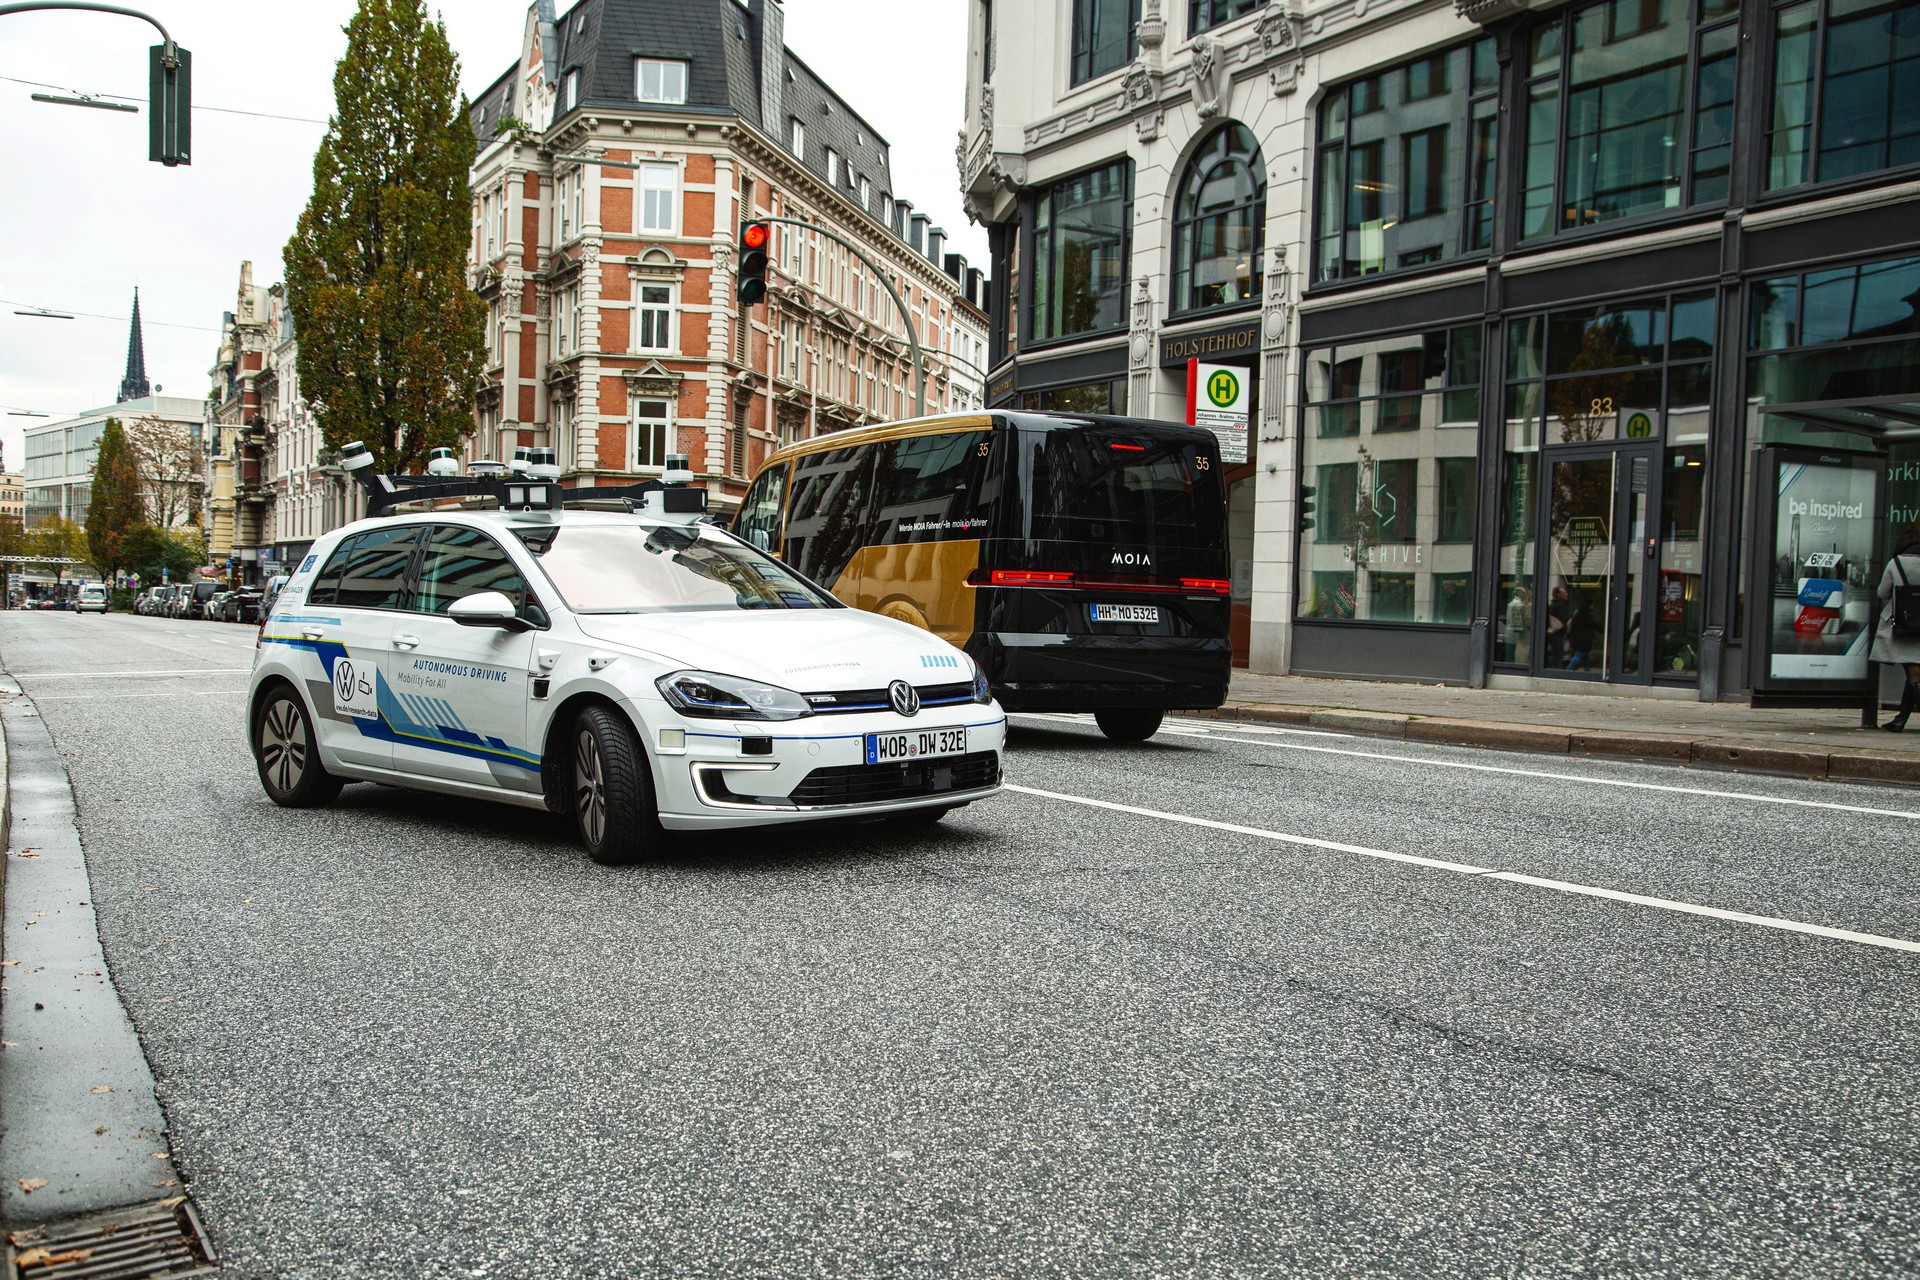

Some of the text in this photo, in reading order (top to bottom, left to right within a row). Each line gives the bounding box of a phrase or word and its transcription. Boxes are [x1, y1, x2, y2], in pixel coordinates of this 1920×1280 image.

[1215, 377, 1231, 400] H
[1591, 396, 1613, 417] 83
[977, 442, 990, 457] 35
[1195, 456, 1210, 471] 35
[1788, 497, 1863, 520] be inspired
[1886, 504, 1920, 523] hiv
[899, 524, 913, 532] Werde
[913, 522, 926, 531] MOIA
[1111, 552, 1151, 566] MOIA
[1344, 545, 1422, 563] BEEHIVE
[1810, 553, 1818, 566] 6
[1097, 605, 1112, 619] HH
[1118, 606, 1132, 619] MO
[1133, 607, 1158, 621] 532E
[413, 659, 508, 682] AUTONOMOUS DRIVING
[397, 672, 447, 689] Mobility For All
[879, 736, 908, 759] WOB
[918, 732, 936, 755] DW
[939, 730, 965, 753] 32E
